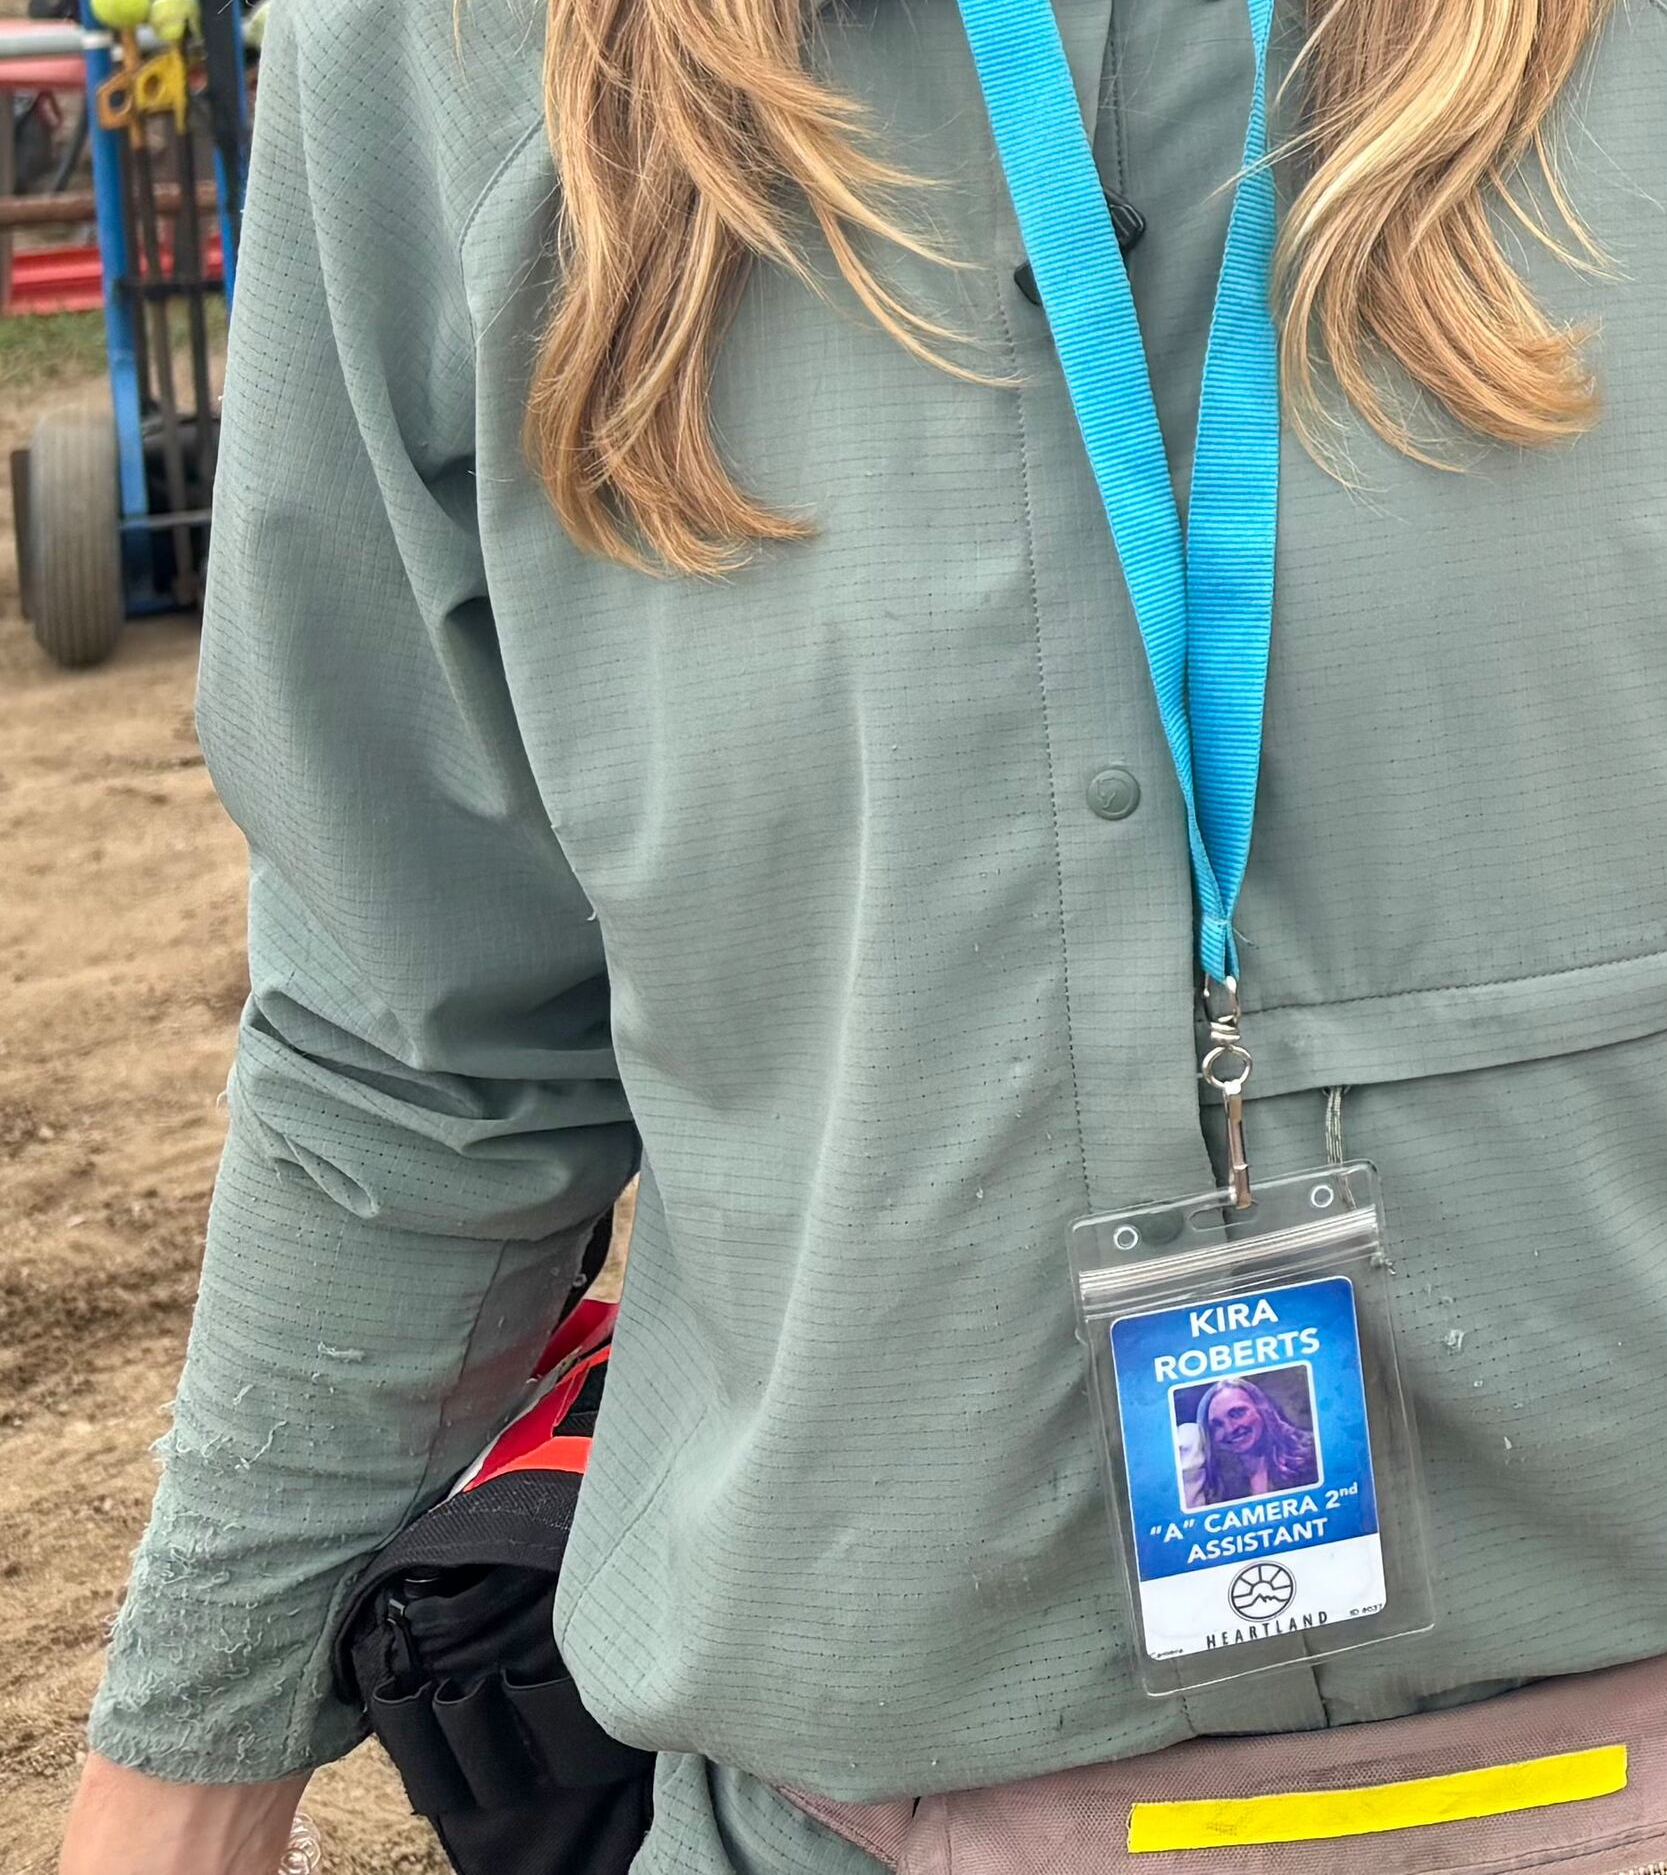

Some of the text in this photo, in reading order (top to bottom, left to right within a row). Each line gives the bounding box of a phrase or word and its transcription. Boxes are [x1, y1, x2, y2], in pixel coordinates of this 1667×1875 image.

[1190, 1298, 1278, 1336] KIRA
[1154, 1328, 1321, 1382] ROBERTS
[1204, 1496, 1318, 1534] CAMERA
[1325, 1482, 1360, 1511] 2nd
[1187, 1518, 1328, 1564] ASSISTANT
[1206, 1610, 1329, 1650] HEARTLAND
